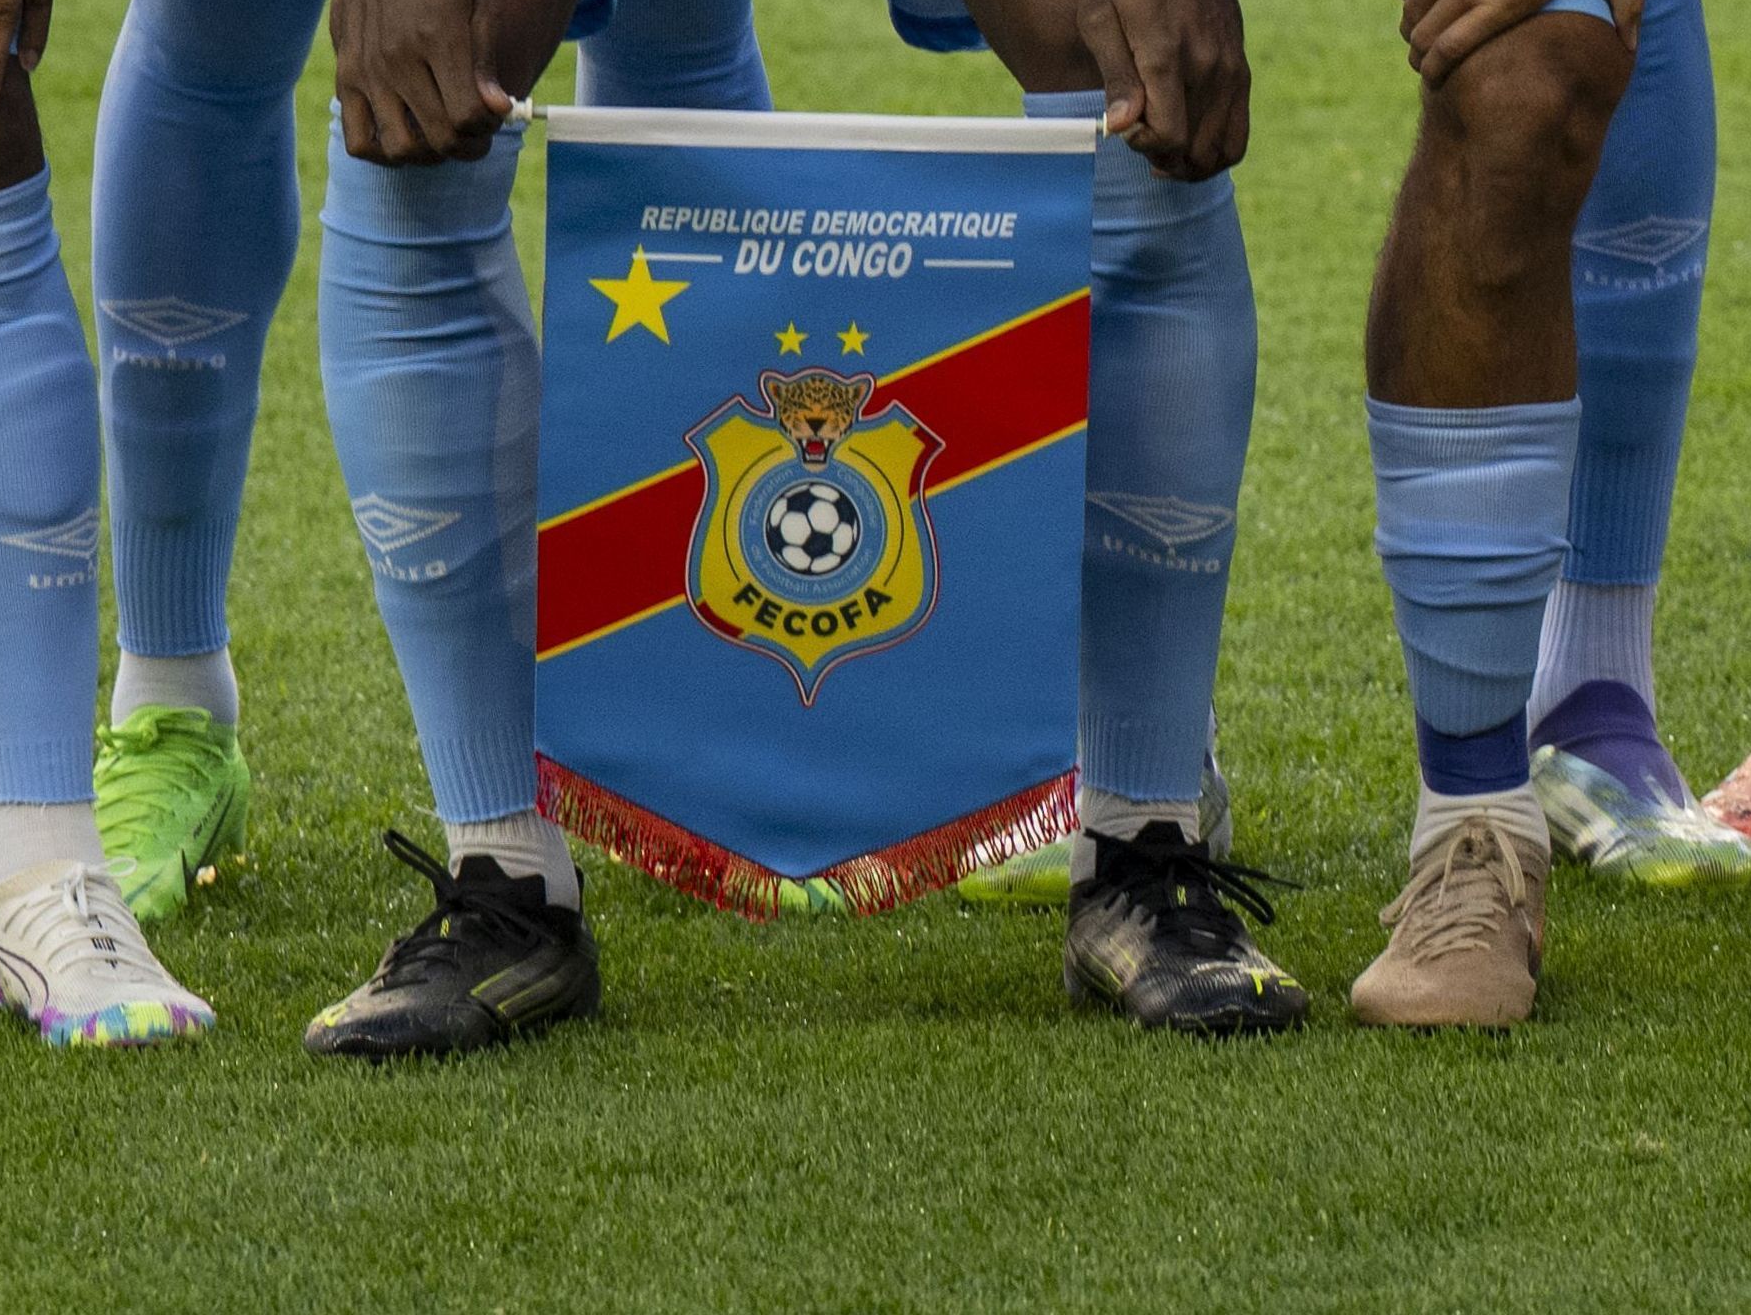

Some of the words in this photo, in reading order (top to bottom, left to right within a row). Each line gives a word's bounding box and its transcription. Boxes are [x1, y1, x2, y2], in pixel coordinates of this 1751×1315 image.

[640, 206, 806, 236] REPUBLIQUE
[811, 210, 1017, 239] DEMOCRATIQUE
[734, 239, 785, 275] DU
[792, 240, 913, 278] CONGO
[733, 582, 892, 638] FECOFA
